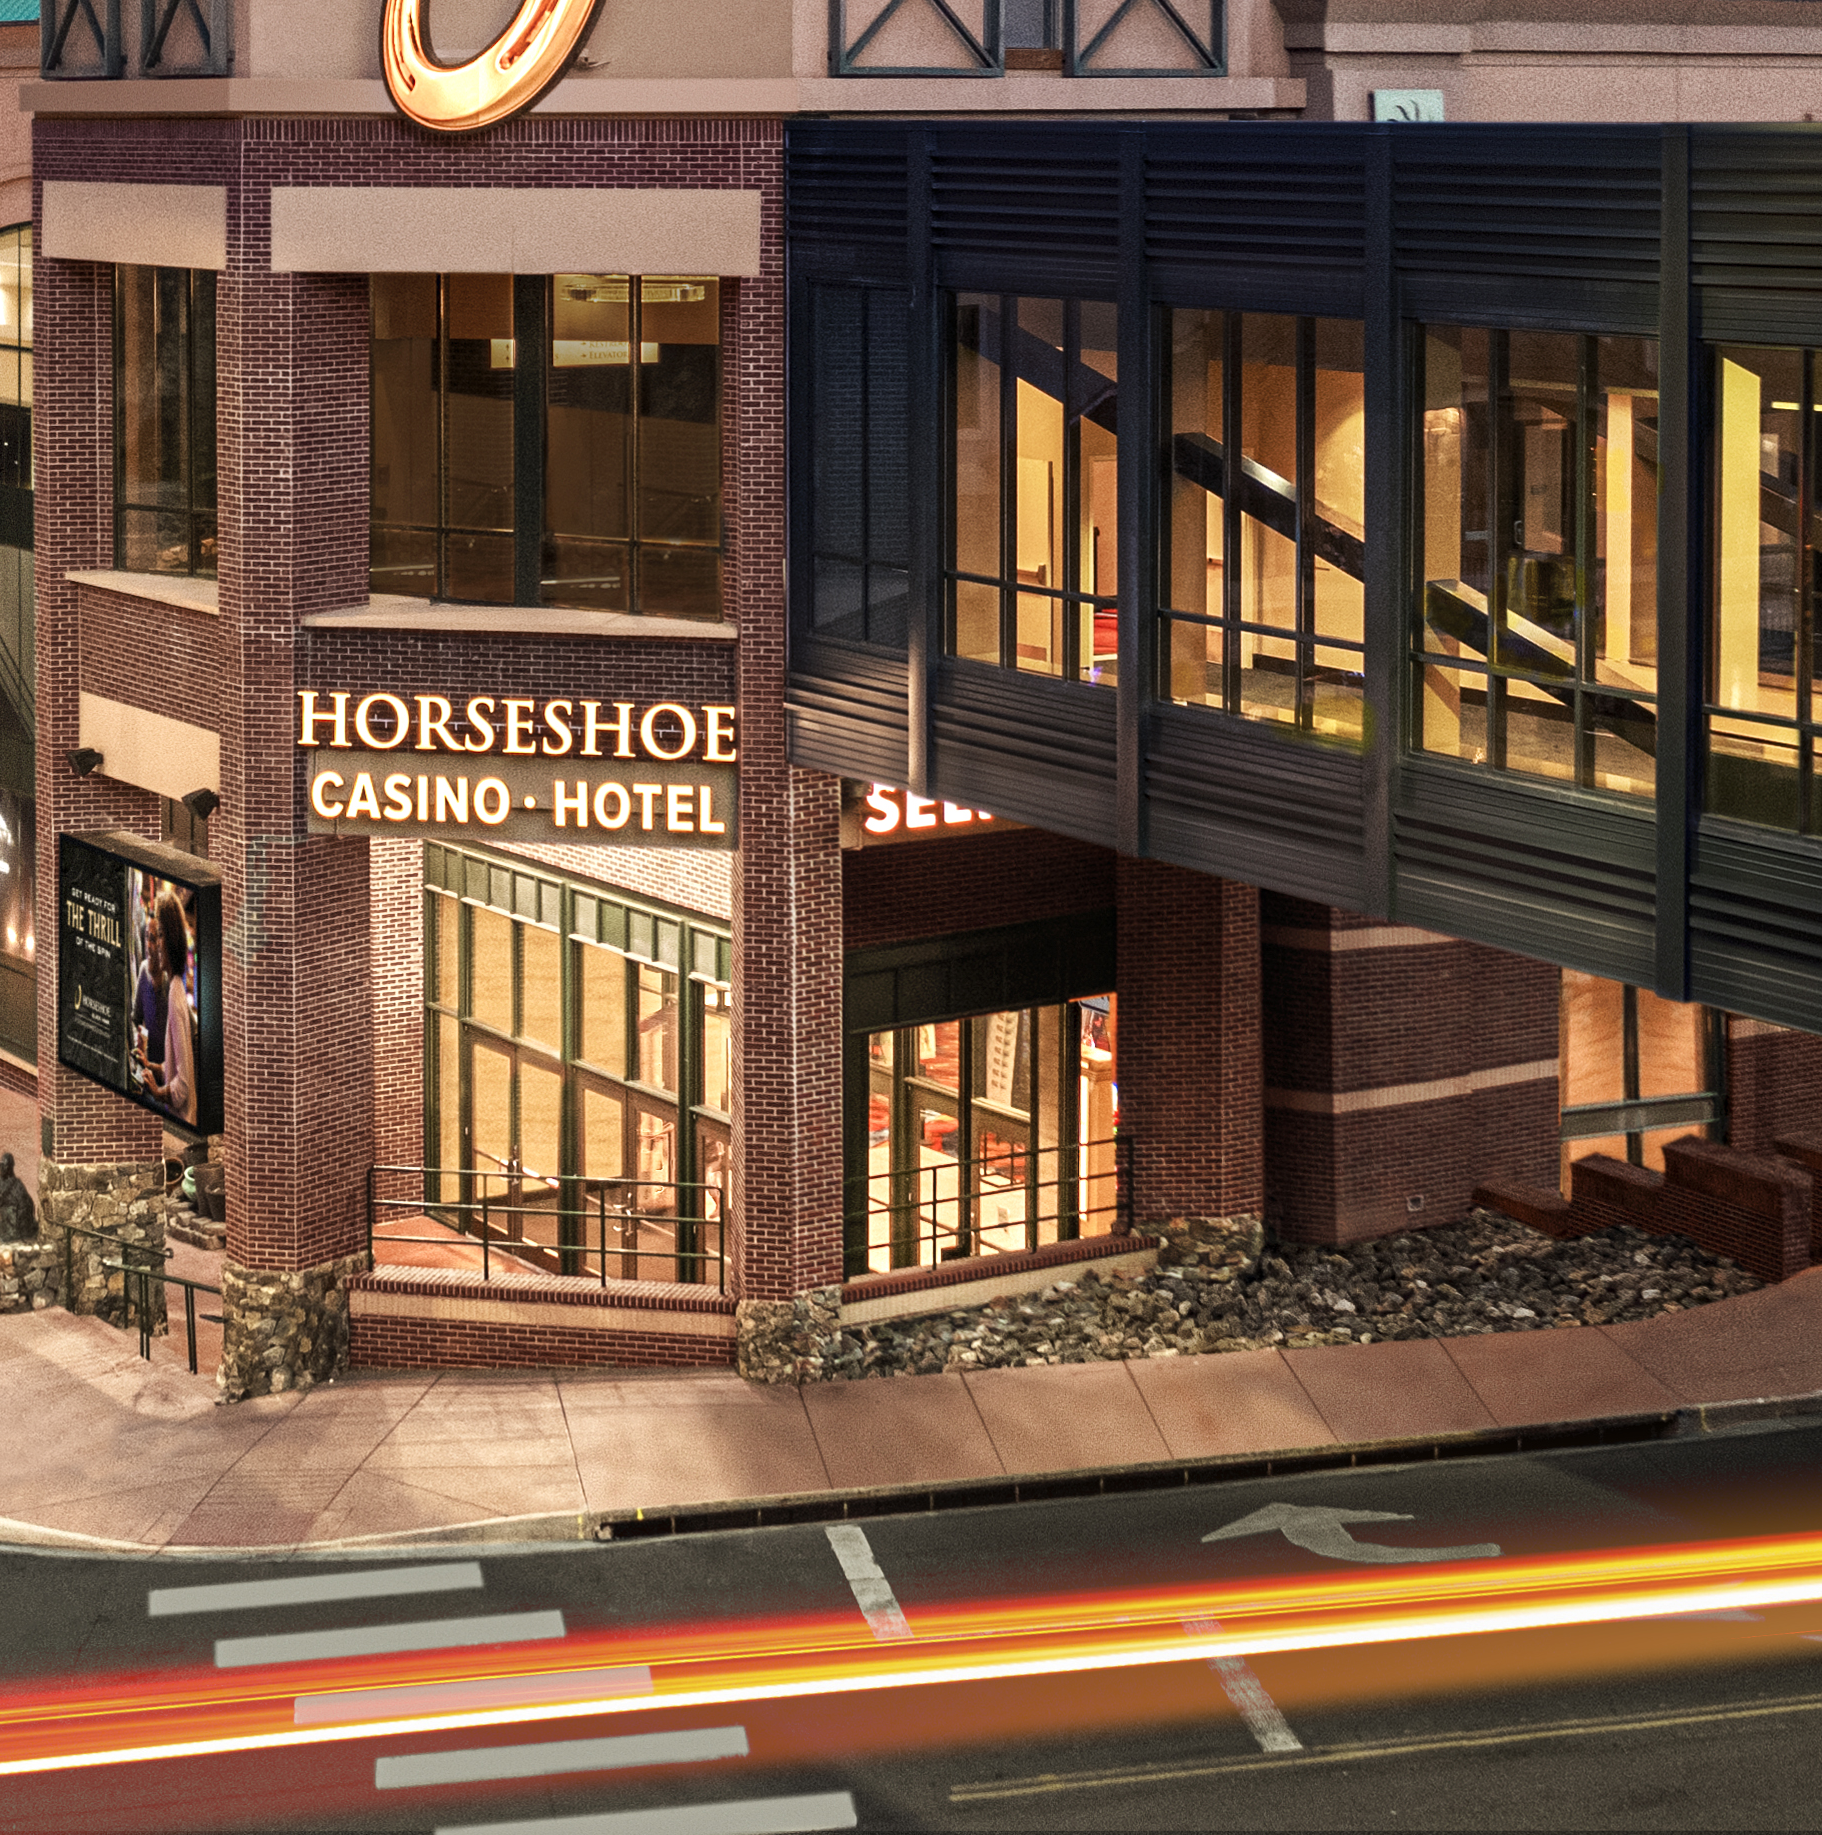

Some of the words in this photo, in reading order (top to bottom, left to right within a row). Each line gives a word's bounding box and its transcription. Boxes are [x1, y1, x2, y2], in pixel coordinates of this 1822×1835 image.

[297, 690, 738, 763] HORSESHOE
[311, 770, 511, 825] CASINO
[553, 780, 726, 834] HOTEL
[66, 900, 85, 932] THE
[87, 909, 122, 948] THRILL
[71, 887, 83, 899] GET
[84, 892, 103, 907] READY
[104, 900, 116, 913] FOR
